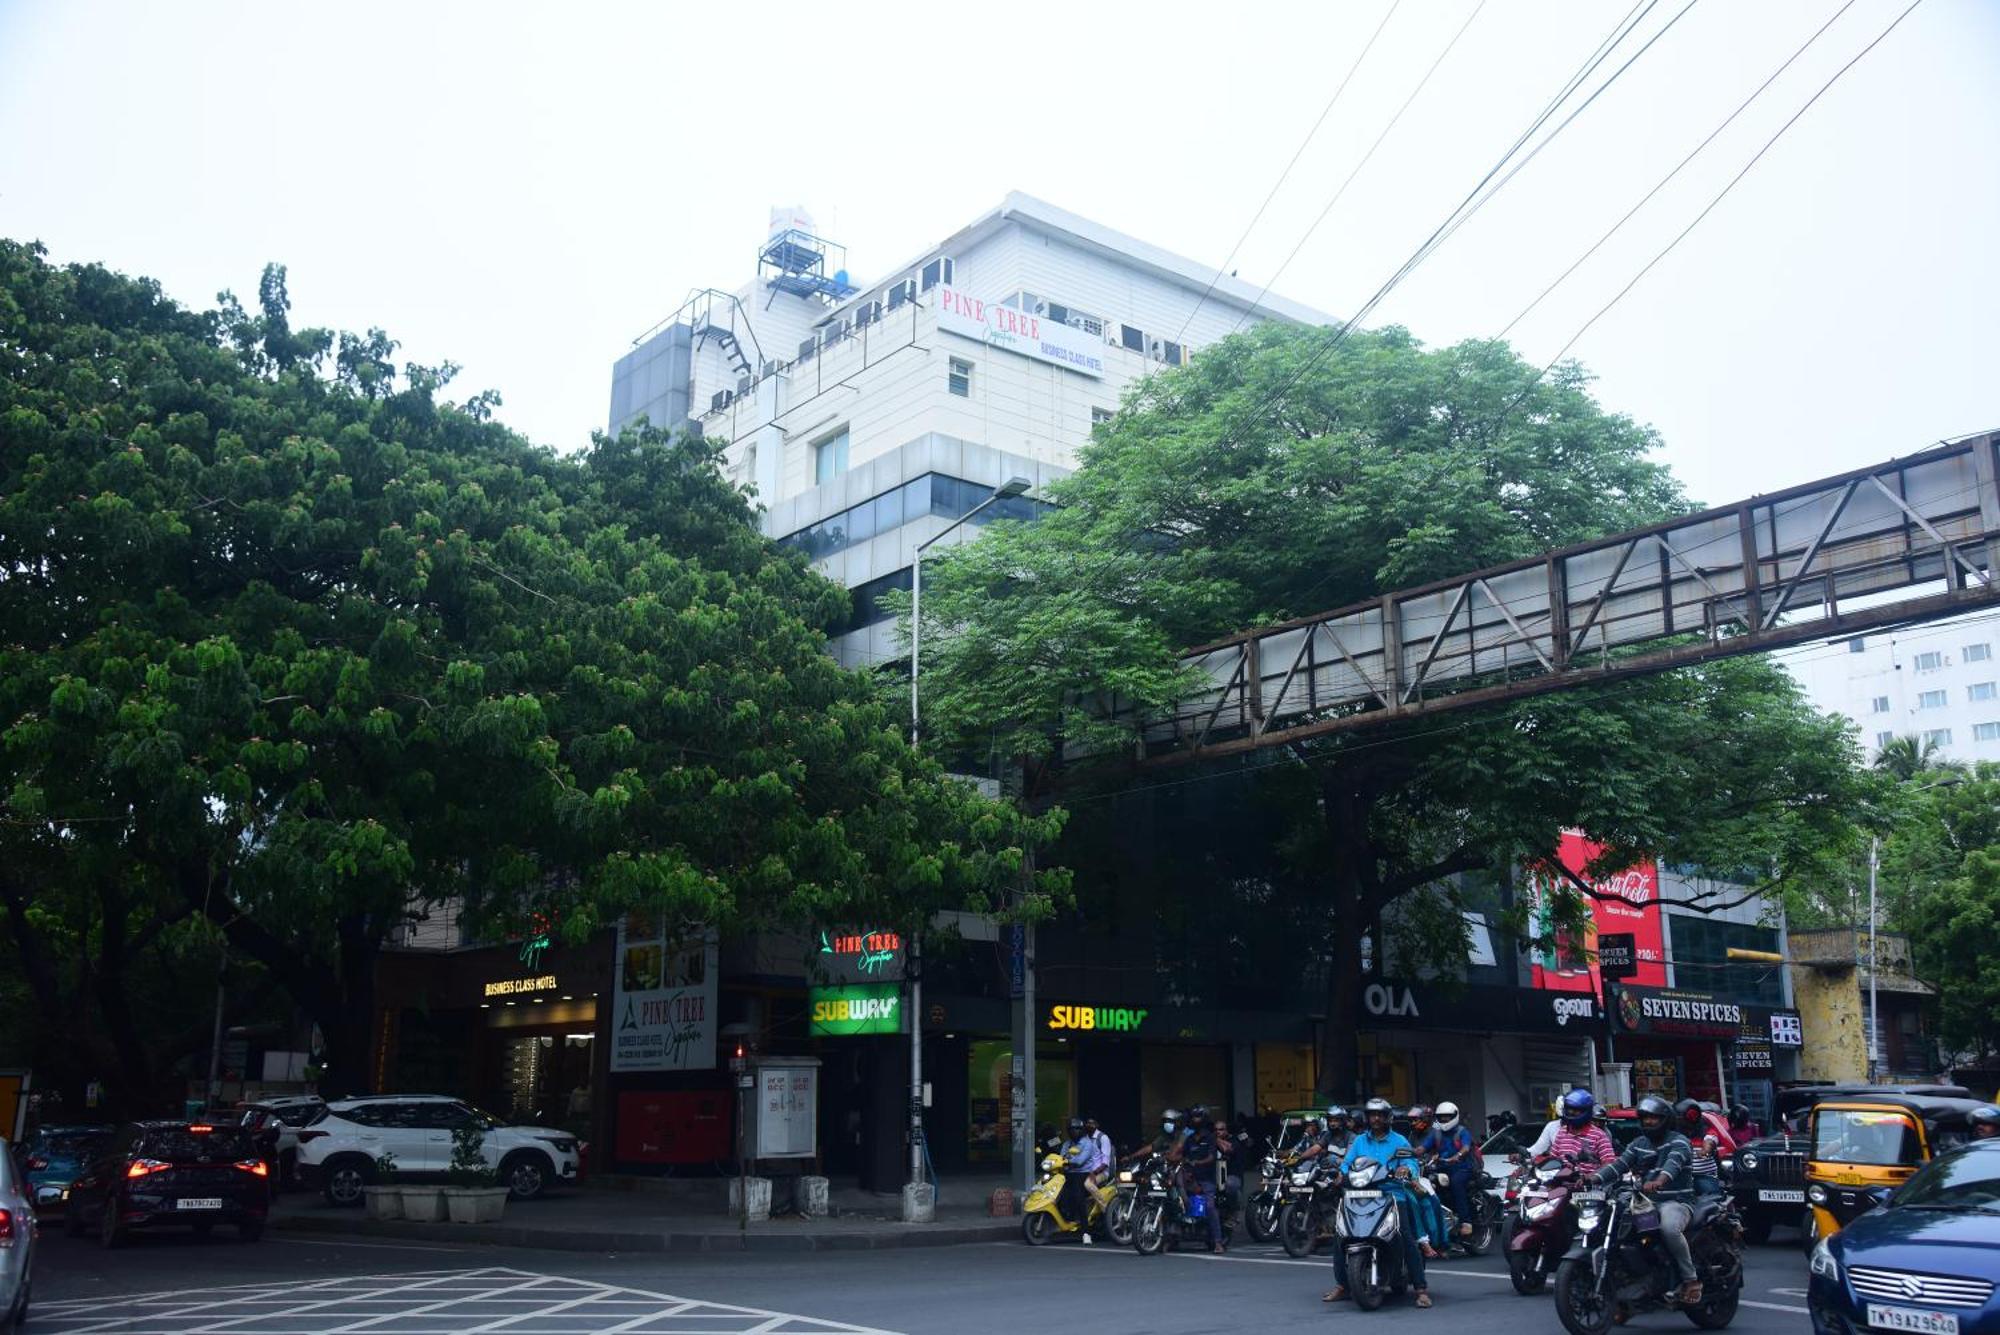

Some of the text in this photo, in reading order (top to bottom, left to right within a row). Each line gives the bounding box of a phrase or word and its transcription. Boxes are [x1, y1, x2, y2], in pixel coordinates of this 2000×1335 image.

[943, 289, 1040, 340] PINE TREE
[835, 933, 898, 953] PINE TREE
[485, 975, 557, 997] BUSINESS CLASS HOTEL
[642, 996, 704, 1026] PINE TREE
[812, 996, 898, 1022] SUBWAY
[1364, 983, 1419, 1016] OLA
[1553, 998, 1593, 1025] ஓலா
[1642, 997, 1692, 1019] SEVEN
[1692, 1002, 1741, 1024] SPICES
[1048, 1005, 1148, 1031] SUBWAY
[1736, 1051, 1770, 1060] SEVEN
[1736, 1059, 1772, 1068] SPICES
[1871, 1310, 1956, 1333] TN19AZ9640
